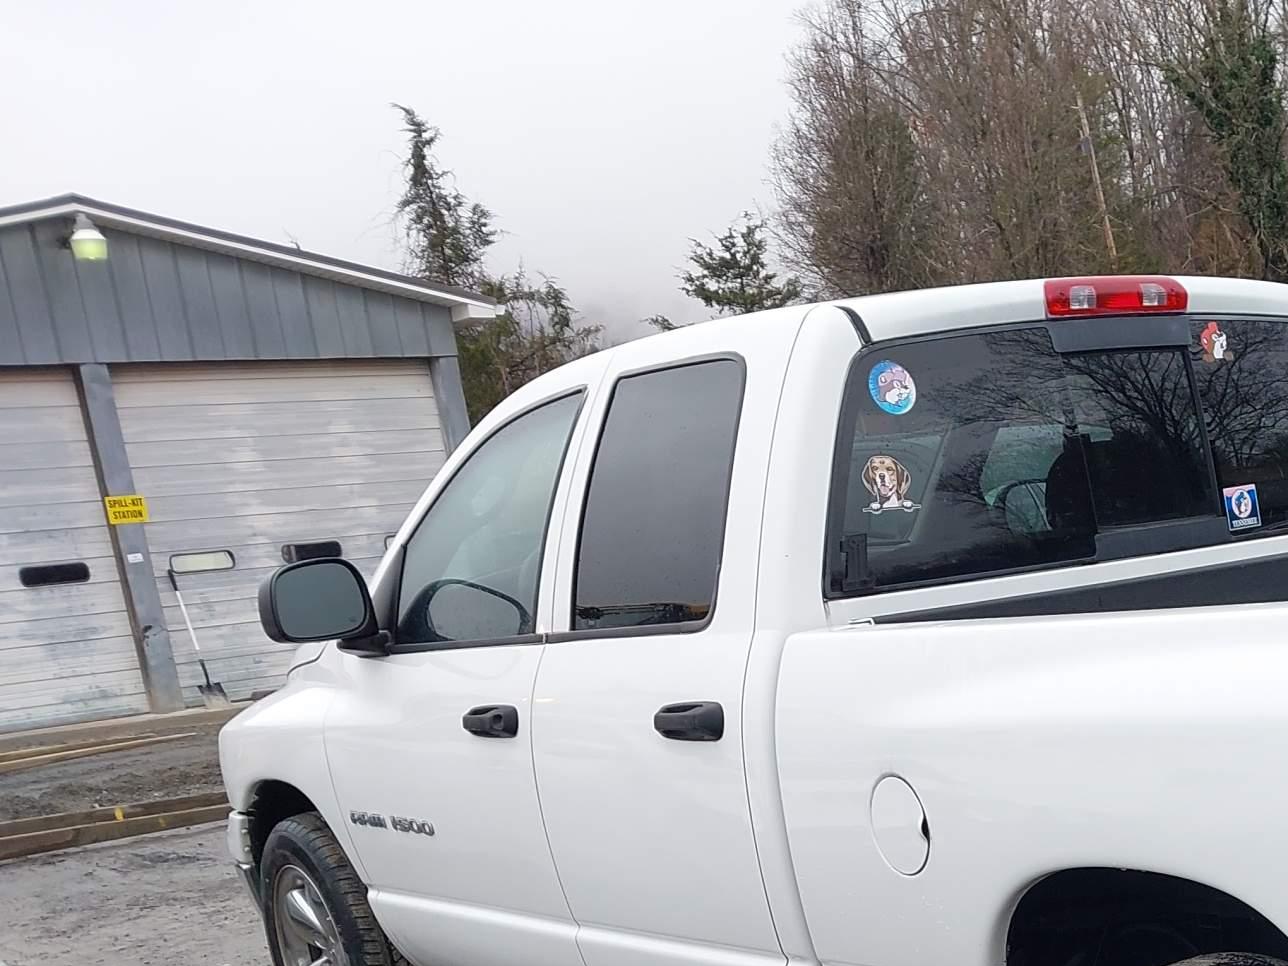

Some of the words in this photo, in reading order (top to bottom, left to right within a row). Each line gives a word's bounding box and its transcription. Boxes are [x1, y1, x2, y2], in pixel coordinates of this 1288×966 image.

[108, 498, 143, 508] SPILL-KIT
[112, 510, 143, 520] STATION
[389, 815, 435, 837] 1500
